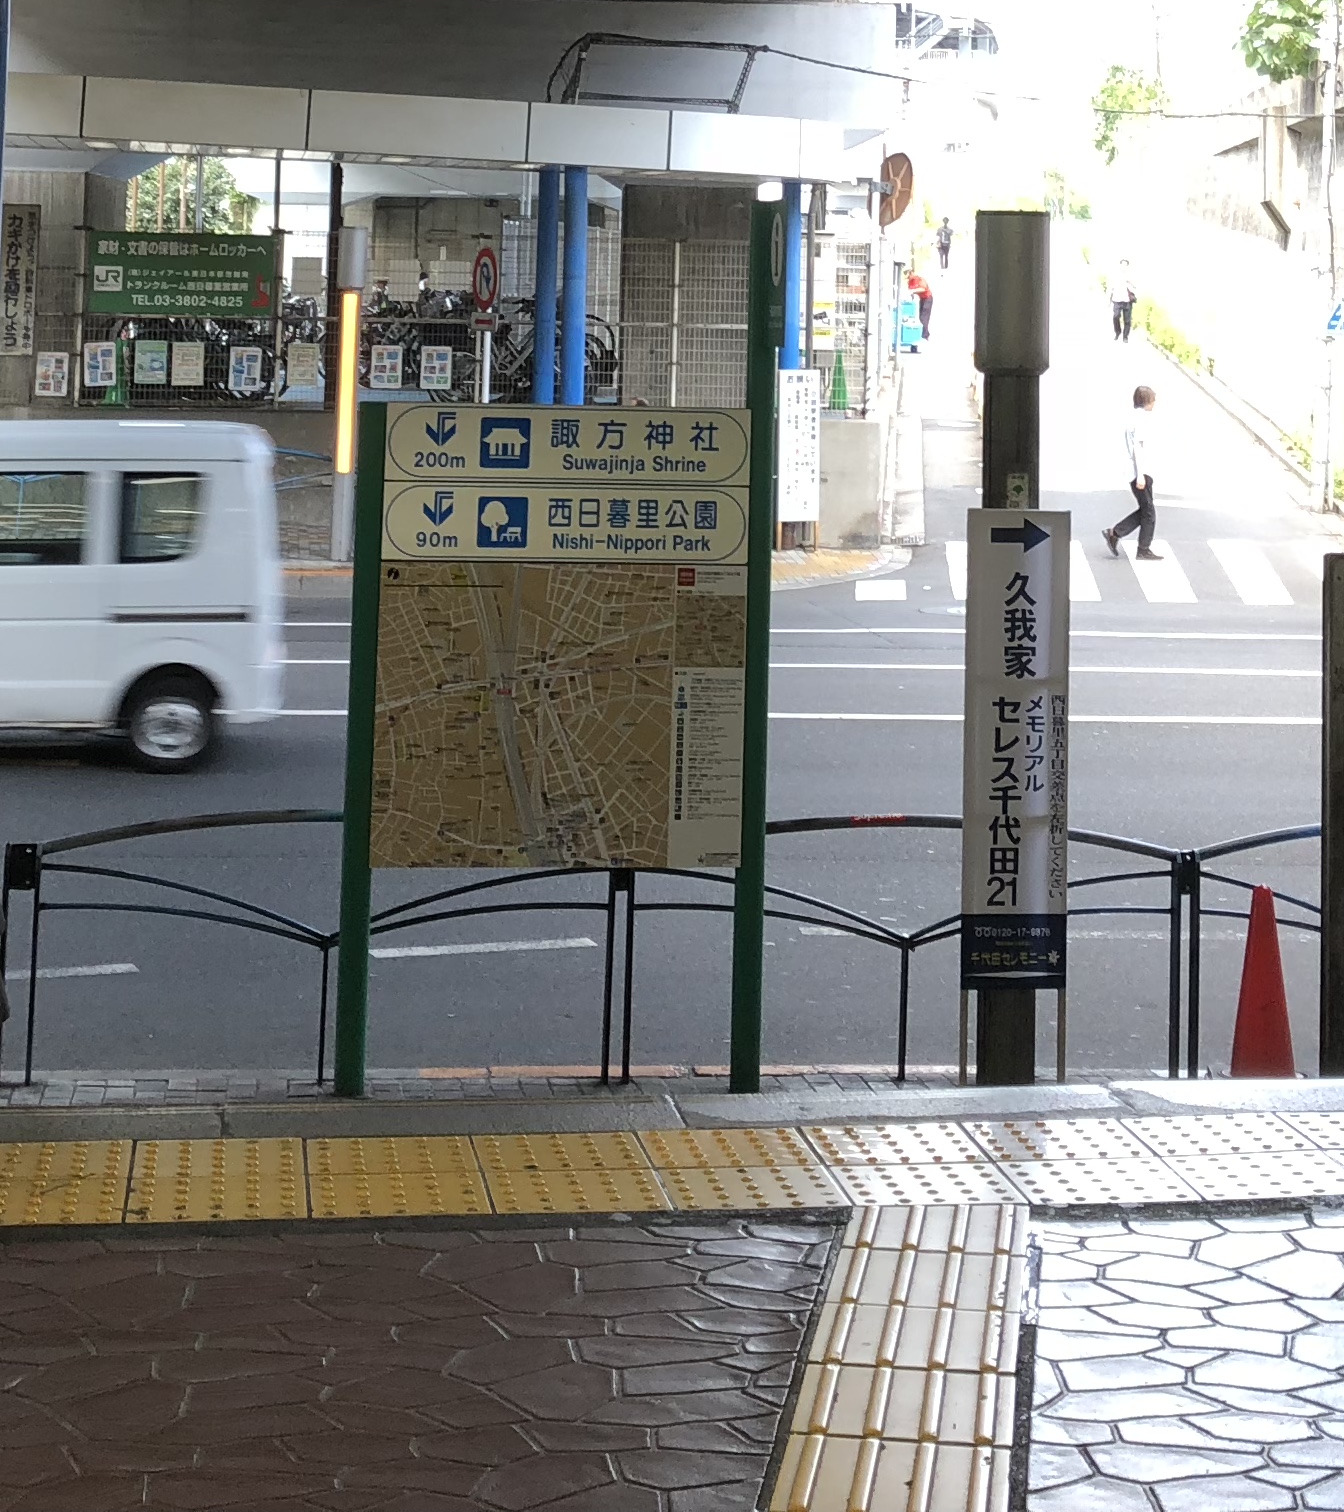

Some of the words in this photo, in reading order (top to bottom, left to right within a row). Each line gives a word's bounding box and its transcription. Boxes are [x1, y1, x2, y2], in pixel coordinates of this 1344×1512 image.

[414, 452, 465, 468] 200m
[562, 454, 645, 474] Suwajinja
[652, 456, 706, 473] Shrine
[548, 498, 717, 530] 西日暮里公園
[415, 531, 458, 548] 90m
[552, 533, 666, 554] Nishi-Nippori
[673, 536, 711, 552] Park
[1004, 572, 1037, 678] 久我家
[1025, 696, 1045, 792] メモリアル
